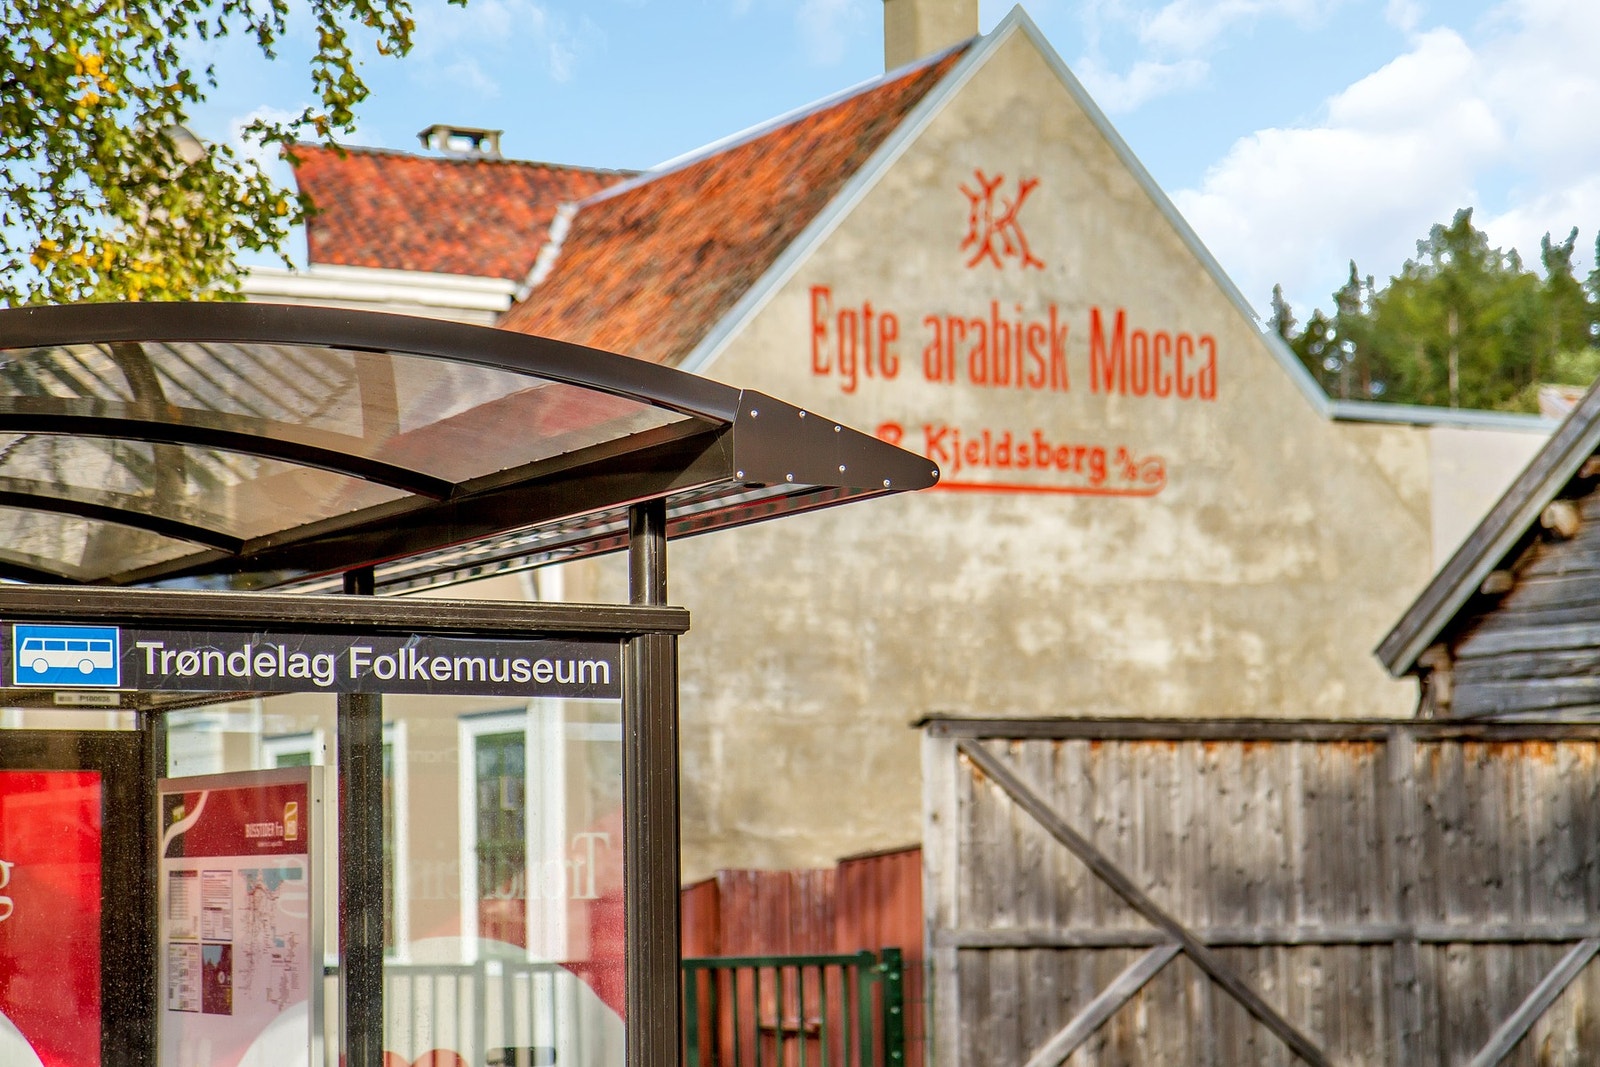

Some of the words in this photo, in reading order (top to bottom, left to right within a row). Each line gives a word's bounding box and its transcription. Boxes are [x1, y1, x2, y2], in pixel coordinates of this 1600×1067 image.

[809, 284, 900, 395] Egte
[922, 300, 1070, 393] arabisk
[1089, 306, 1218, 401] Mocca
[922, 422, 1107, 485] Kjeldsberg
[136, 641, 334, 687] Trøndelag
[349, 646, 610, 684] Folkemuseum
